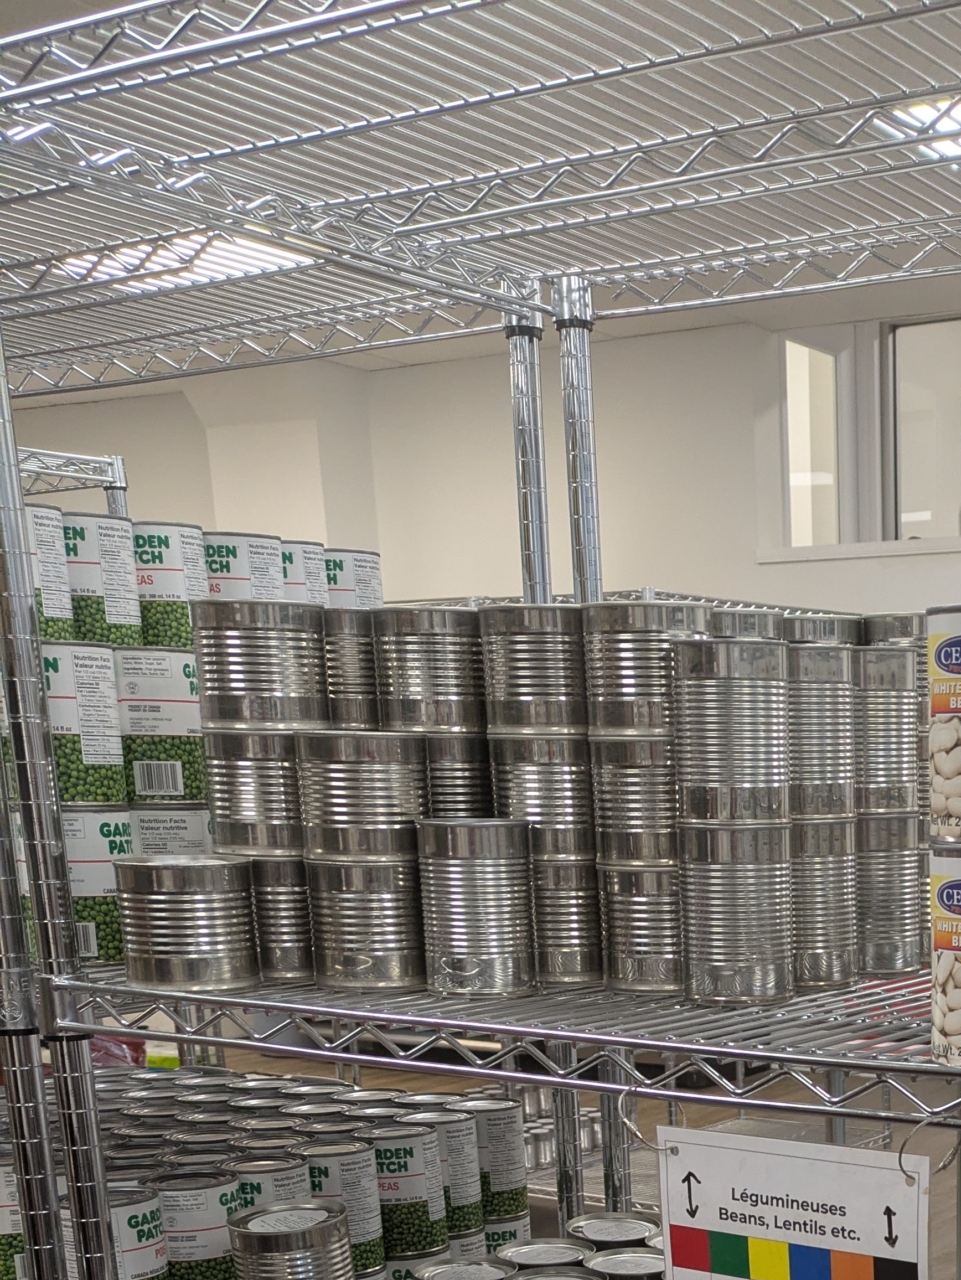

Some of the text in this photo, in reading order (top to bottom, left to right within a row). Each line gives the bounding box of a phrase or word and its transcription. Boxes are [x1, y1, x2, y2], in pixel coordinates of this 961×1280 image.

[731, 1188, 847, 1216] Légumineuses
[718, 1207, 860, 1242] Beans, Lentils etc.
